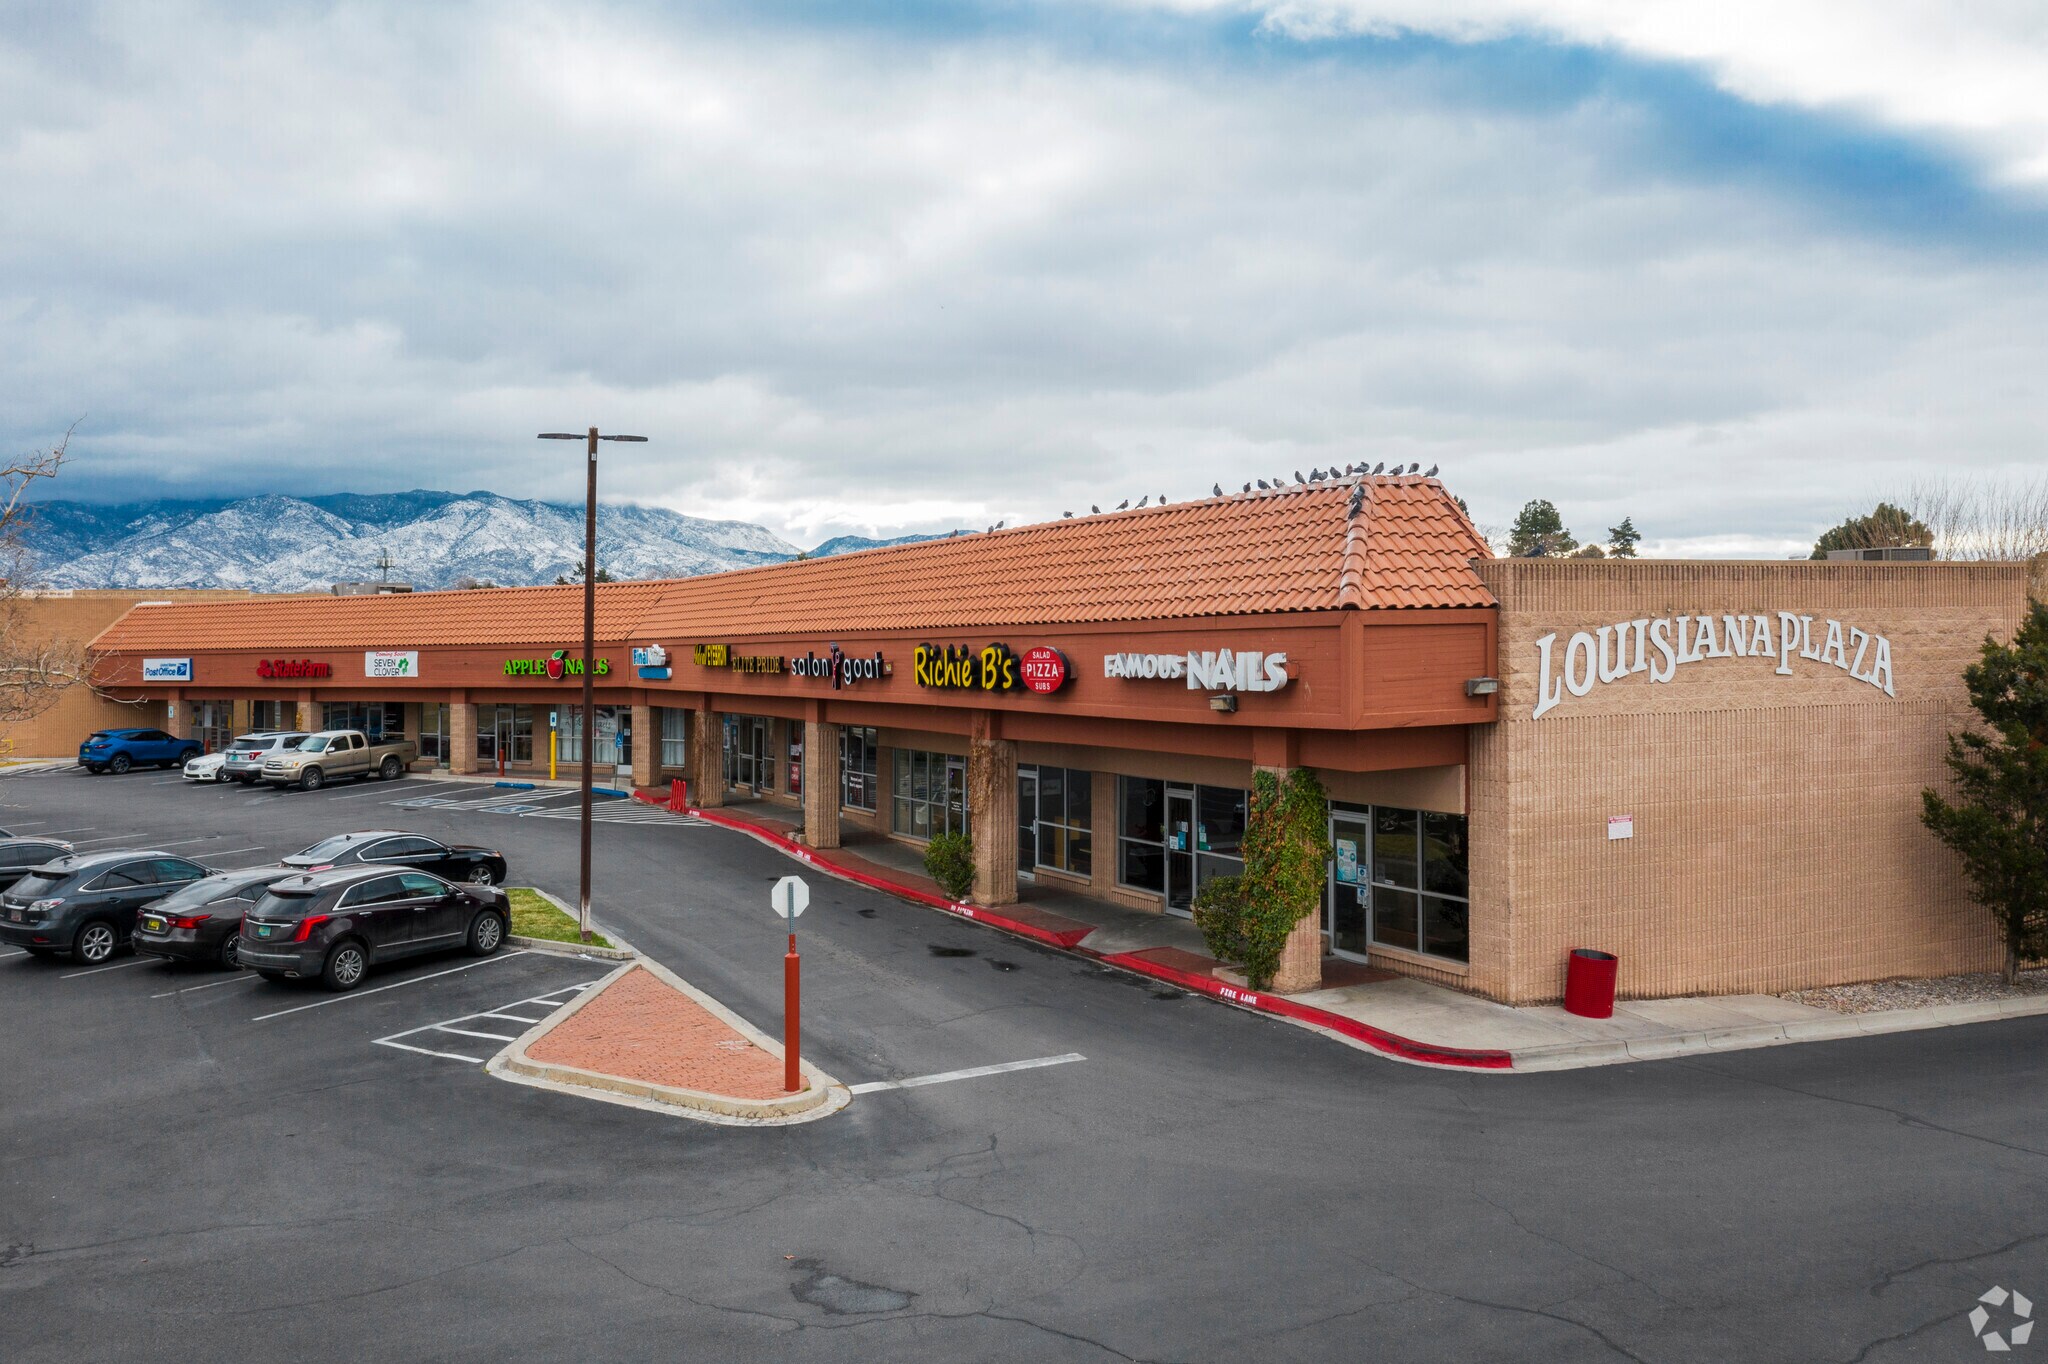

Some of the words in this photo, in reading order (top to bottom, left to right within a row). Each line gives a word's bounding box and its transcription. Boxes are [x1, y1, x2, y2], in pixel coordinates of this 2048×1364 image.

[374, 659, 397, 668] SEVEN
[1032, 651, 1051, 660] SALAD
[374, 668, 400, 676] CLOVER
[503, 659, 546, 675] APPLE
[565, 658, 609, 675] NALS
[732, 656, 755, 673] ELITE
[756, 656, 781, 674] PRIDE
[791, 651, 828, 677] salon
[843, 651, 883, 685] goat
[914, 646, 972, 688] Richie
[981, 646, 1013, 690] B's
[1026, 663, 1059, 678] PIZZA
[1104, 653, 1184, 679] FAMOUS
[1187, 648, 1288, 692] NAILS
[1532, 615, 1776, 720] LOUISIANA
[1775, 611, 1895, 698] PLAZA
[1035, 682, 1051, 691] SUBS
[1220, 987, 1237, 999] FIRE
[1240, 993, 1258, 1005] LANE
